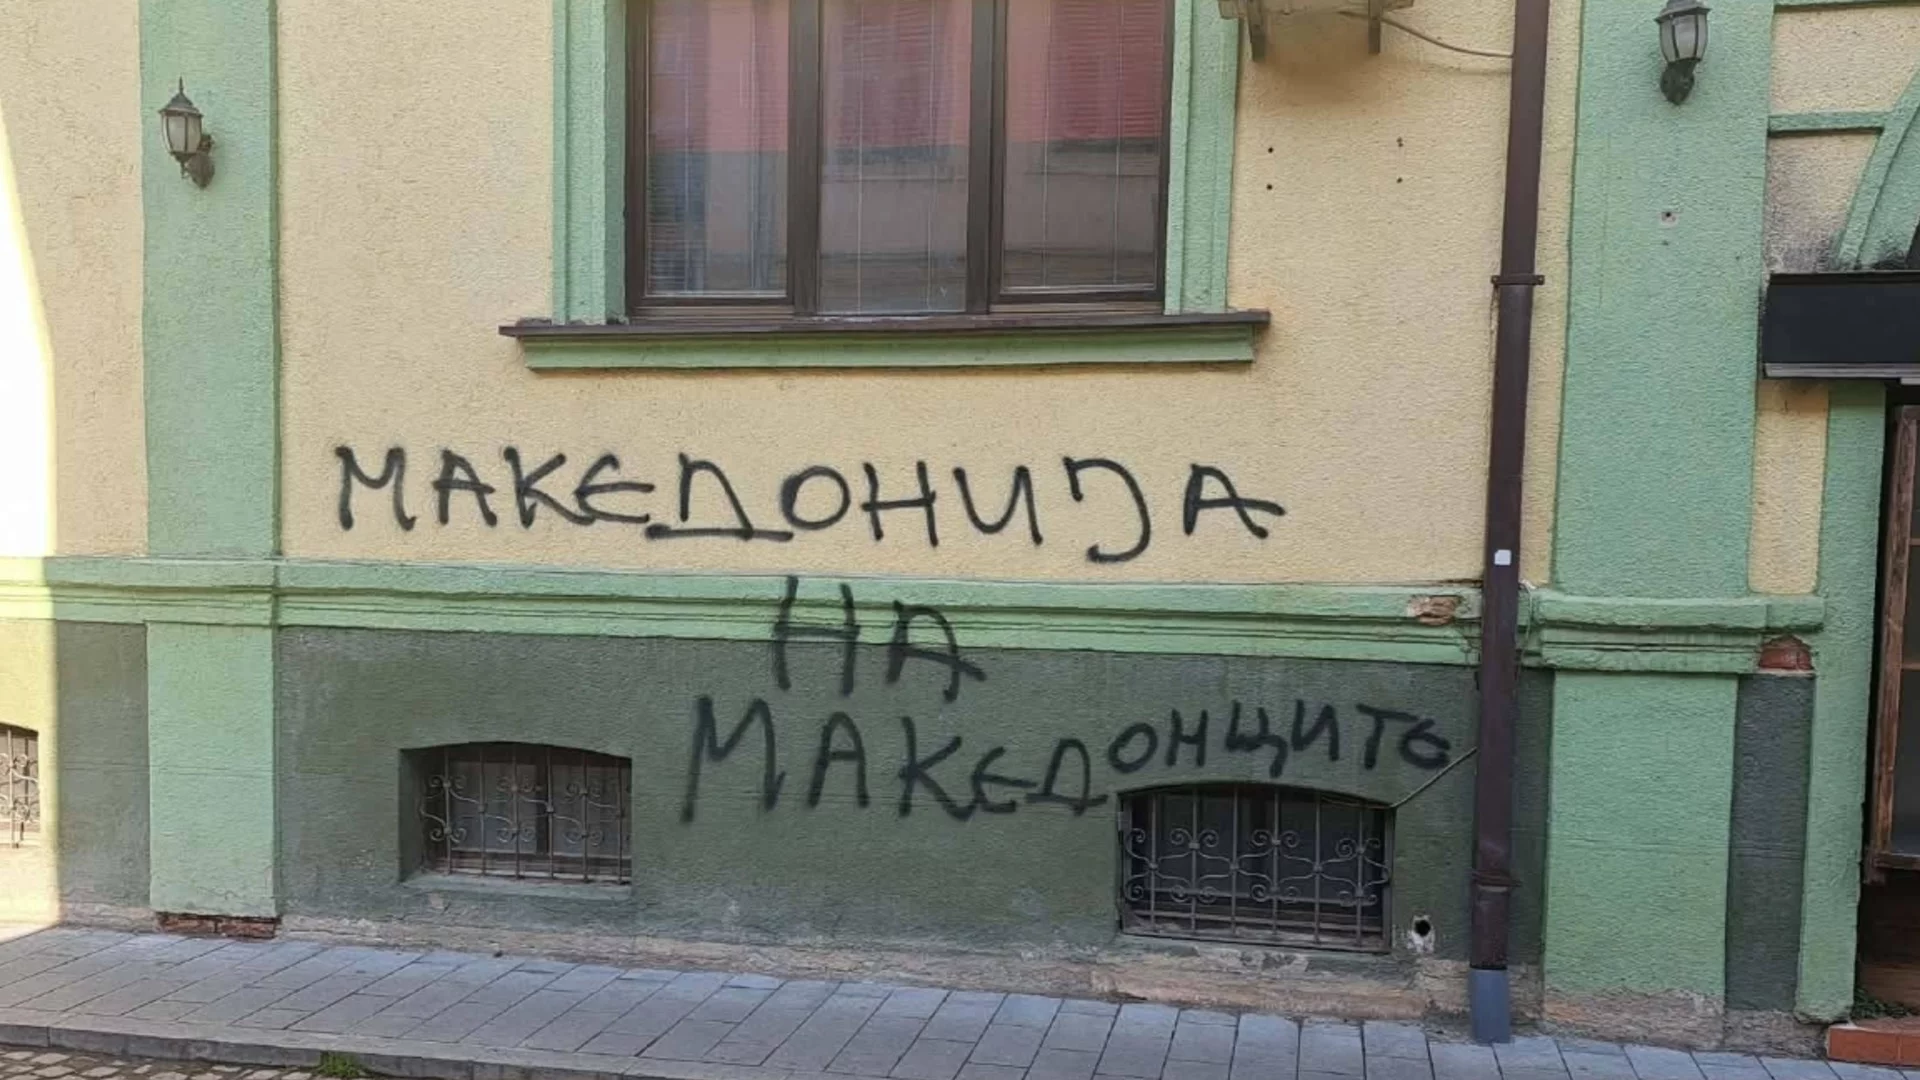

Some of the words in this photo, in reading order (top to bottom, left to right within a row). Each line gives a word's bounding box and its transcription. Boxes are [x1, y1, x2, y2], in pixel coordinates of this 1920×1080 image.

[336, 446, 1286, 563] МАКЕДОНИЈА
[771, 575, 987, 701] НА
[680, 695, 1452, 824] МАКЕДОНЦИТЕ
